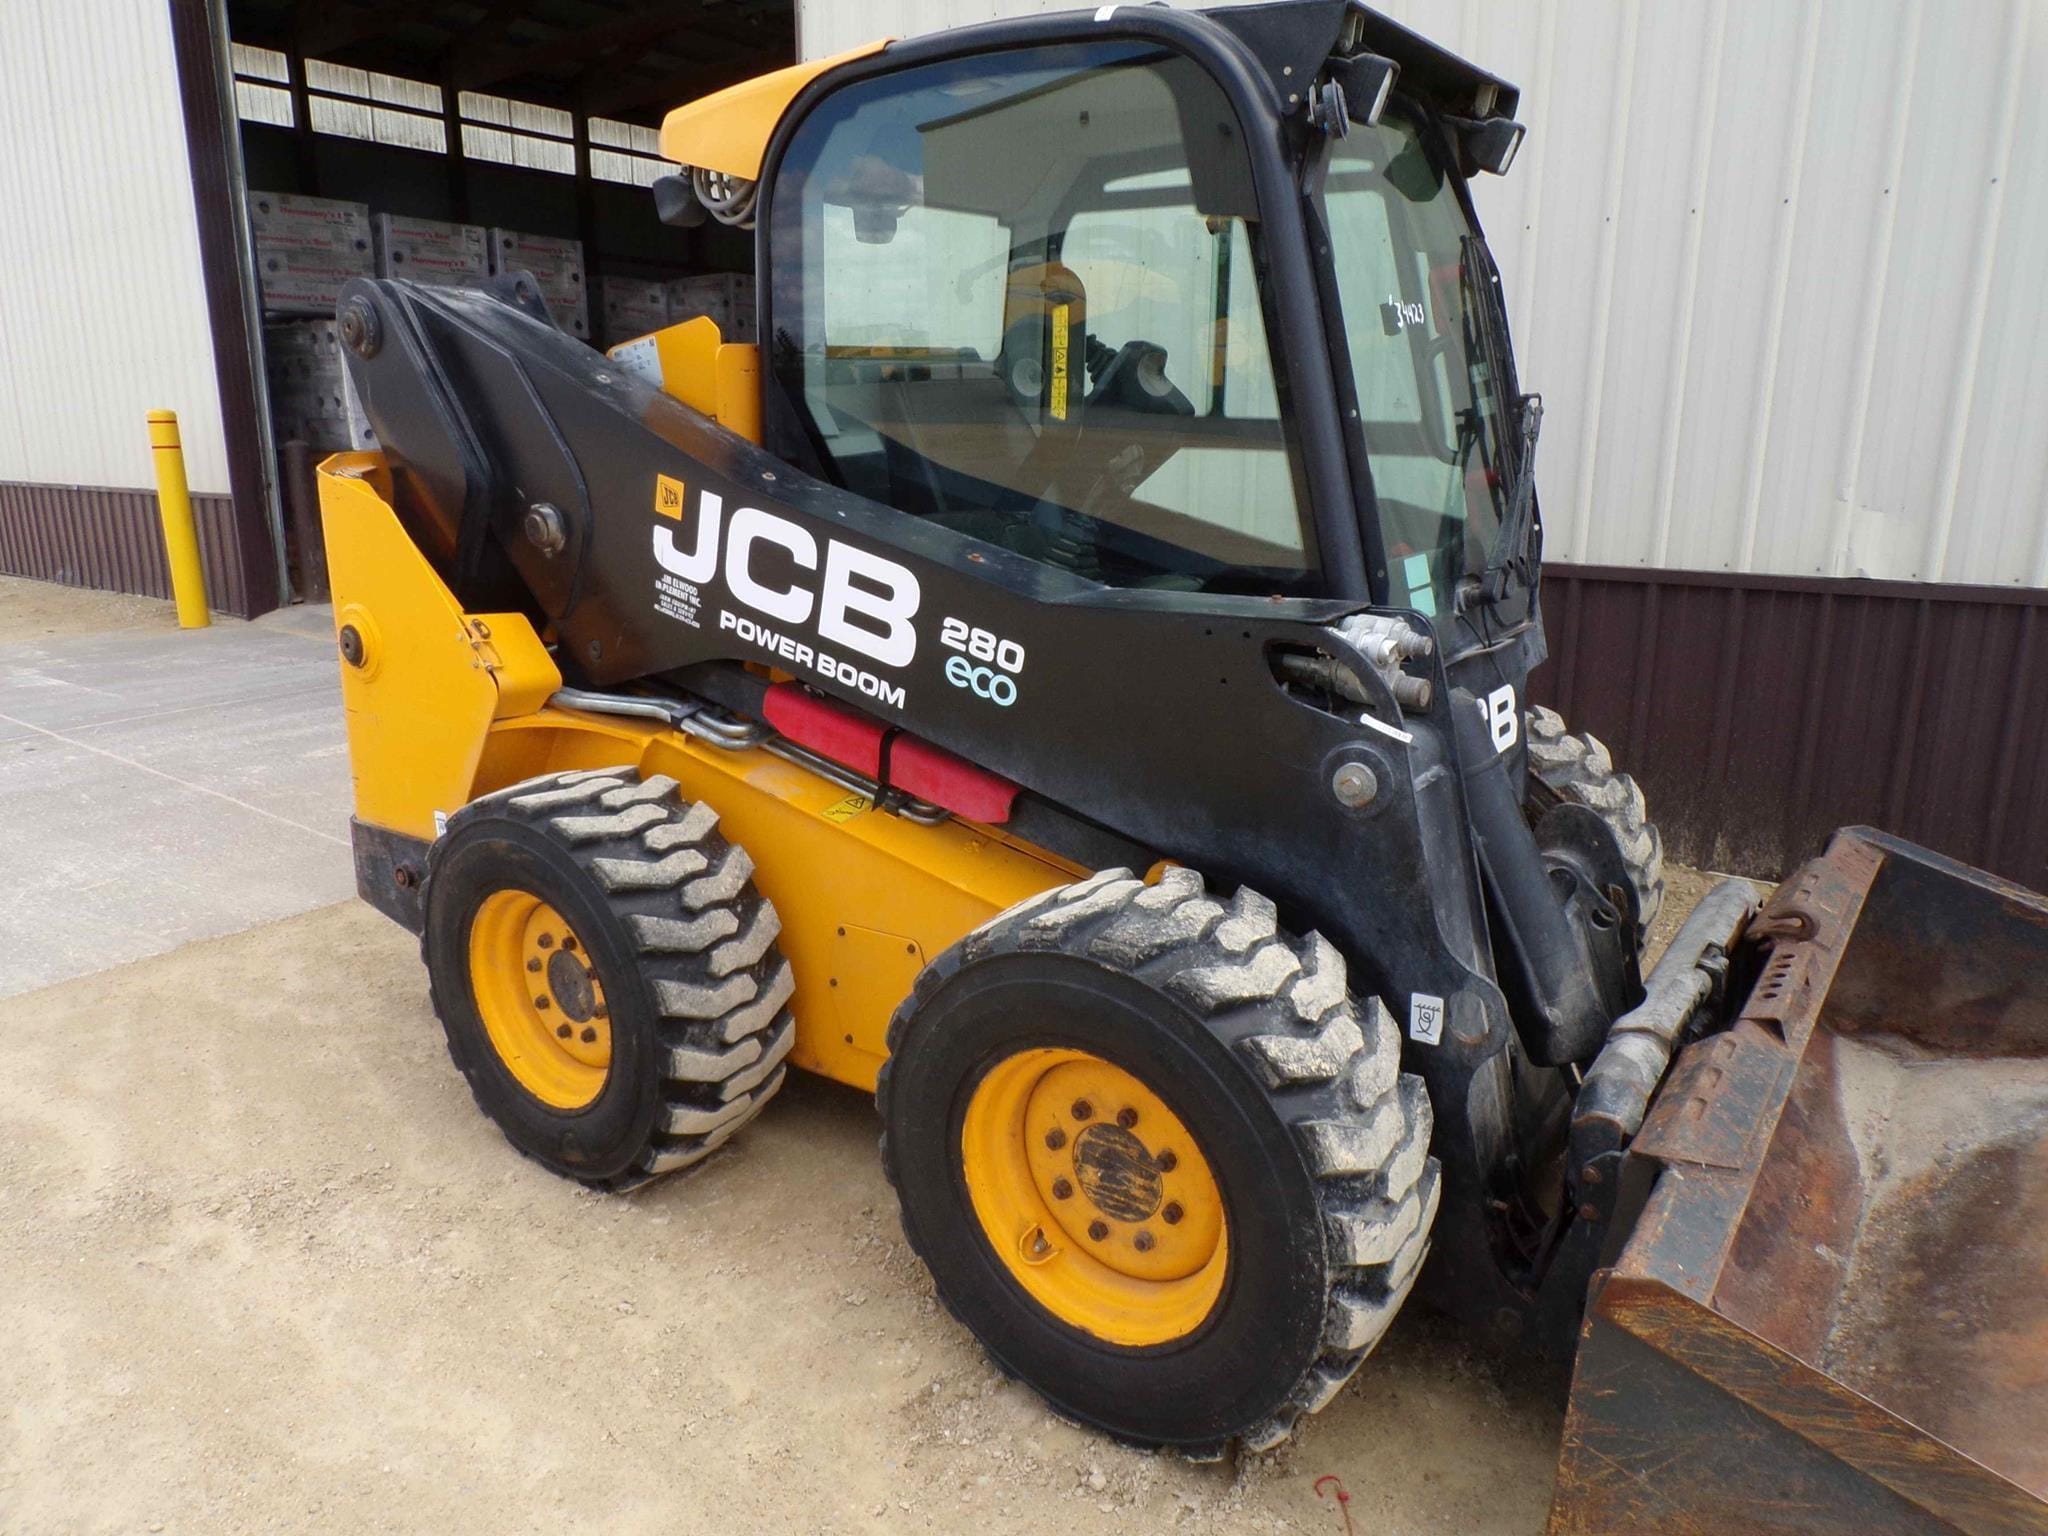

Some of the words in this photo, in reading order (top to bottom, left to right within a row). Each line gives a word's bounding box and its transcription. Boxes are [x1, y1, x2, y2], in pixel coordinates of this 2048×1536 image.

[663, 486, 680, 505] JCB
[653, 489, 921, 668] JCB
[719, 609, 815, 669] POWER
[816, 652, 907, 710] BOOM
[940, 616, 1026, 674] 280
[945, 655, 1018, 707] eco
